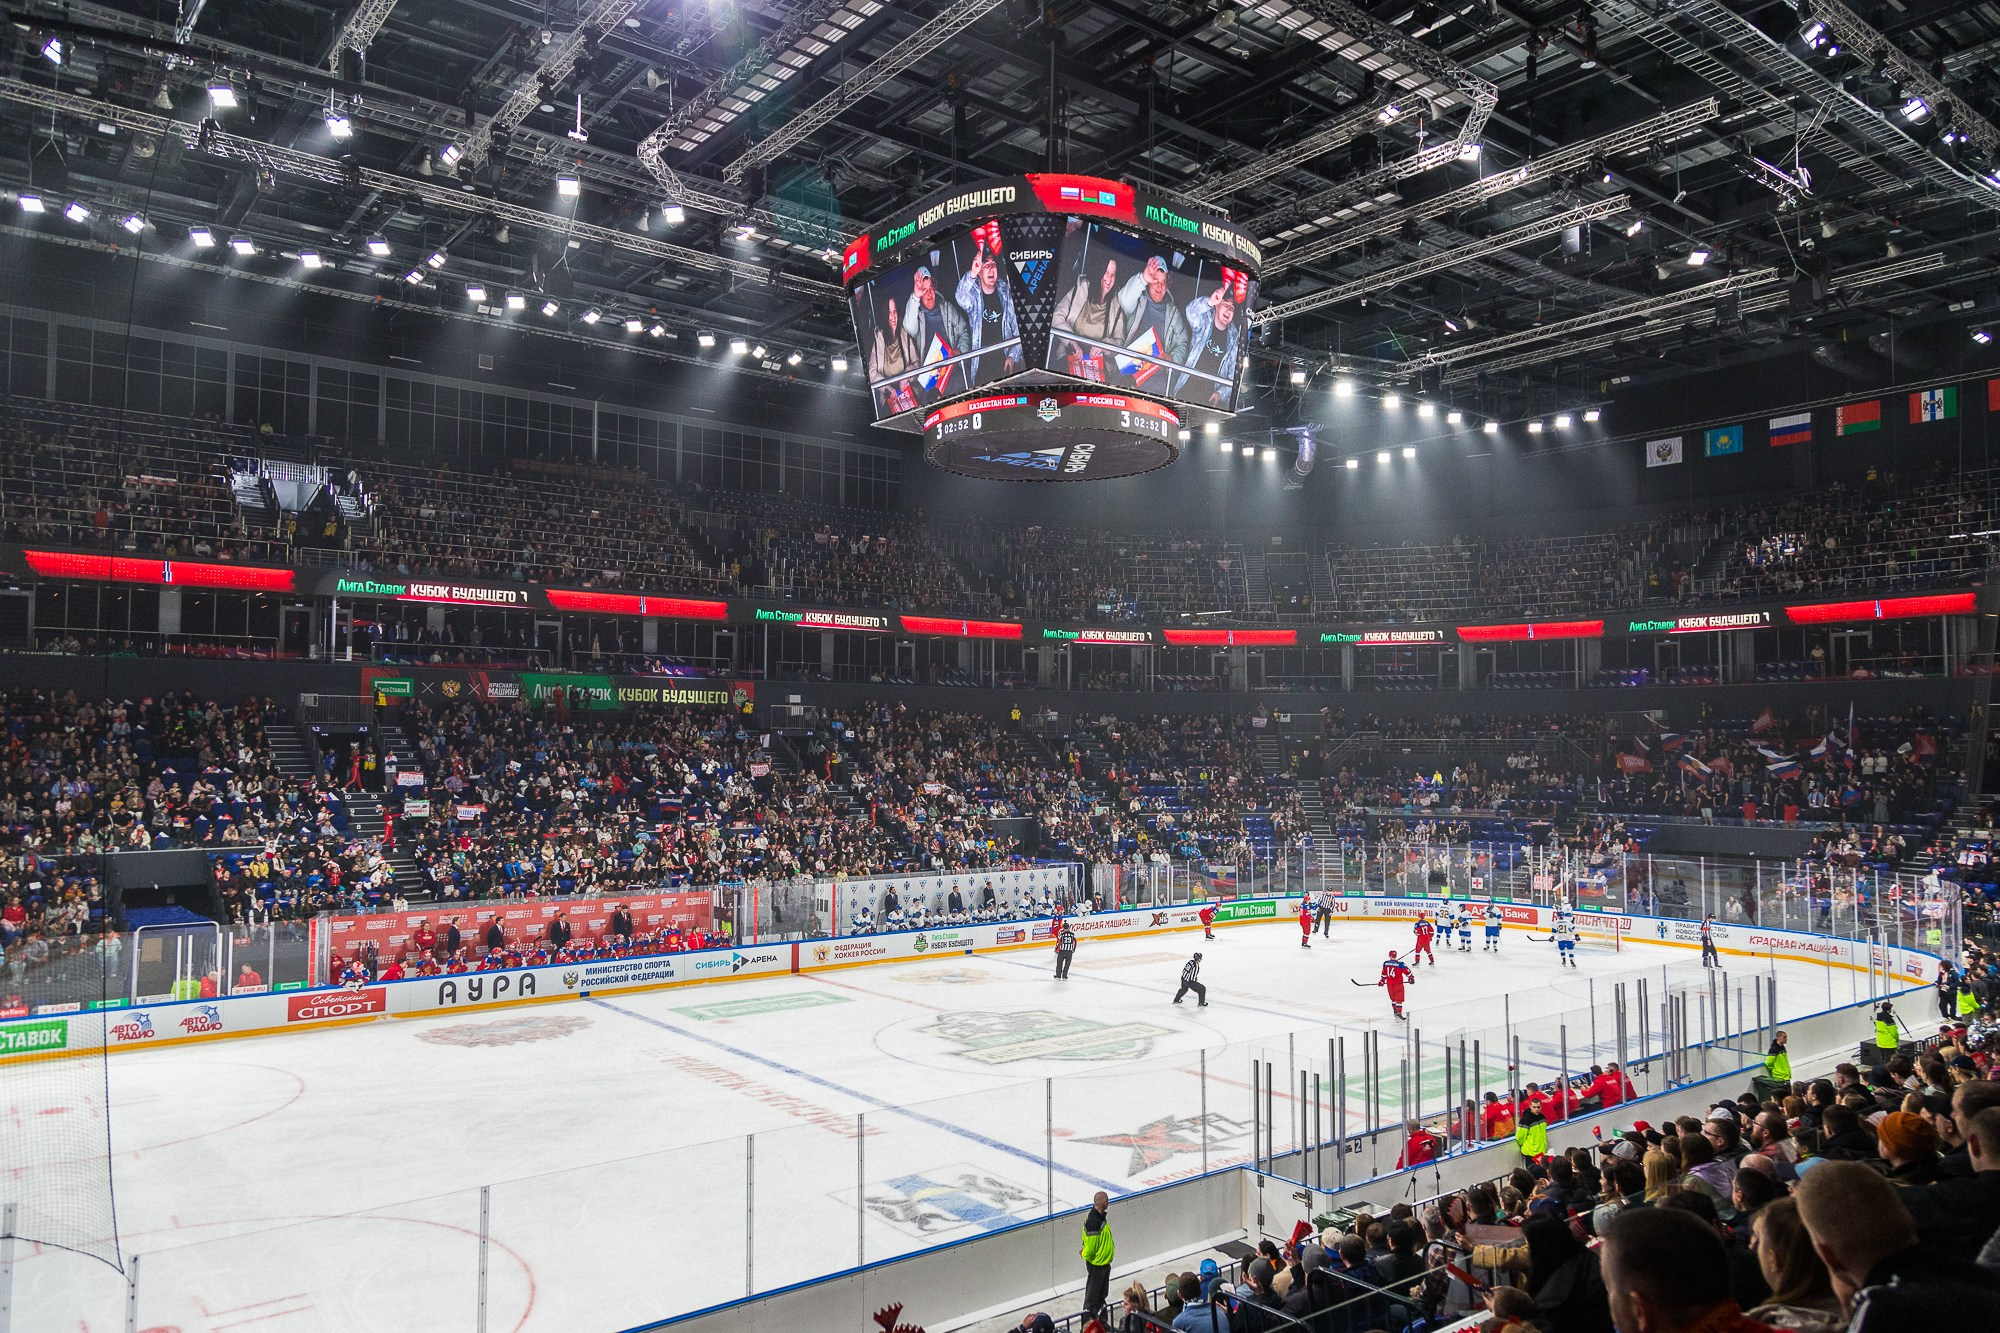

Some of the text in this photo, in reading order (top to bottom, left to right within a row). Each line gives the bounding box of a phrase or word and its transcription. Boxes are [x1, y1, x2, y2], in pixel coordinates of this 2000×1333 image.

[918, 203, 945, 230] КУБОК
[946, 186, 1016, 215] БУДУЩЕГО
[1202, 222, 1234, 247] КУБОК
[1010, 250, 1053, 260] СИБИРЬ
[1028, 260, 1050, 294] АРЕНА
[968, 398, 1015, 410] КАЗАХСТАН U20
[1089, 396, 1125, 407] РОССИЯ U20
[936, 422, 943, 440] 3
[945, 419, 968, 434] 02:52
[972, 413, 981, 430] 0
[1121, 410, 1168, 437] 3 02:52 0
[410, 584, 449, 599] КУБОК
[452, 587, 516, 603] БУДУЩЕГО
[806, 612, 833, 624] КУБОК
[835, 615, 880, 627] БУДУЩЕГО
[1678, 618, 1707, 629] КУБОК
[1709, 613, 1760, 627] БУДУЩЕГО
[1081, 631, 1105, 640] КУБОК
[1106, 632, 1145, 641] БУДУЩЕГО
[1364, 632, 1389, 642] КУБОК
[1391, 631, 1435, 641] БУДУЩЕГО
[488, 688, 519, 696] МАШИНА
[618, 687, 728, 704] КУБОК БУДУЩЕГО
[1439, 909, 1449, 919] 32
[1505, 908, 1529, 920] Банк
[1071, 918, 1132, 932] КРАСНАЯ МАШИНА
[1421, 926, 1428, 935] 17
[1558, 925, 1567, 933] 21
[834, 941, 872, 952] ФЕДЕРАЦИЯ
[931, 937, 974, 950] КУБОК БУДУЩЕГО
[1749, 935, 1839, 955] КРАСНАЯ МАШИНА
[834, 947, 886, 959] ХОККЕЯ РОССИИ
[585, 960, 671, 976] МИНИСТЕРСТВО СПОРТА
[695, 954, 778, 970] СИБИРЬ АРЕНА
[581, 970, 675, 987] РОССИЙСКОЙ ФЕДЕРАЦИИ
[1387, 966, 1396, 978] 14
[439, 973, 536, 1005] АУРА
[311, 993, 368, 1005] Советский
[297, 1001, 377, 1018] СПОРТ
[179, 1016, 208, 1027] АВТО
[186, 1022, 223, 1034] РАДИО
[109, 1023, 139, 1035] АВТО
[117, 1029, 155, 1042] РАДИО
[1355, 1139, 1362, 1152] 2
